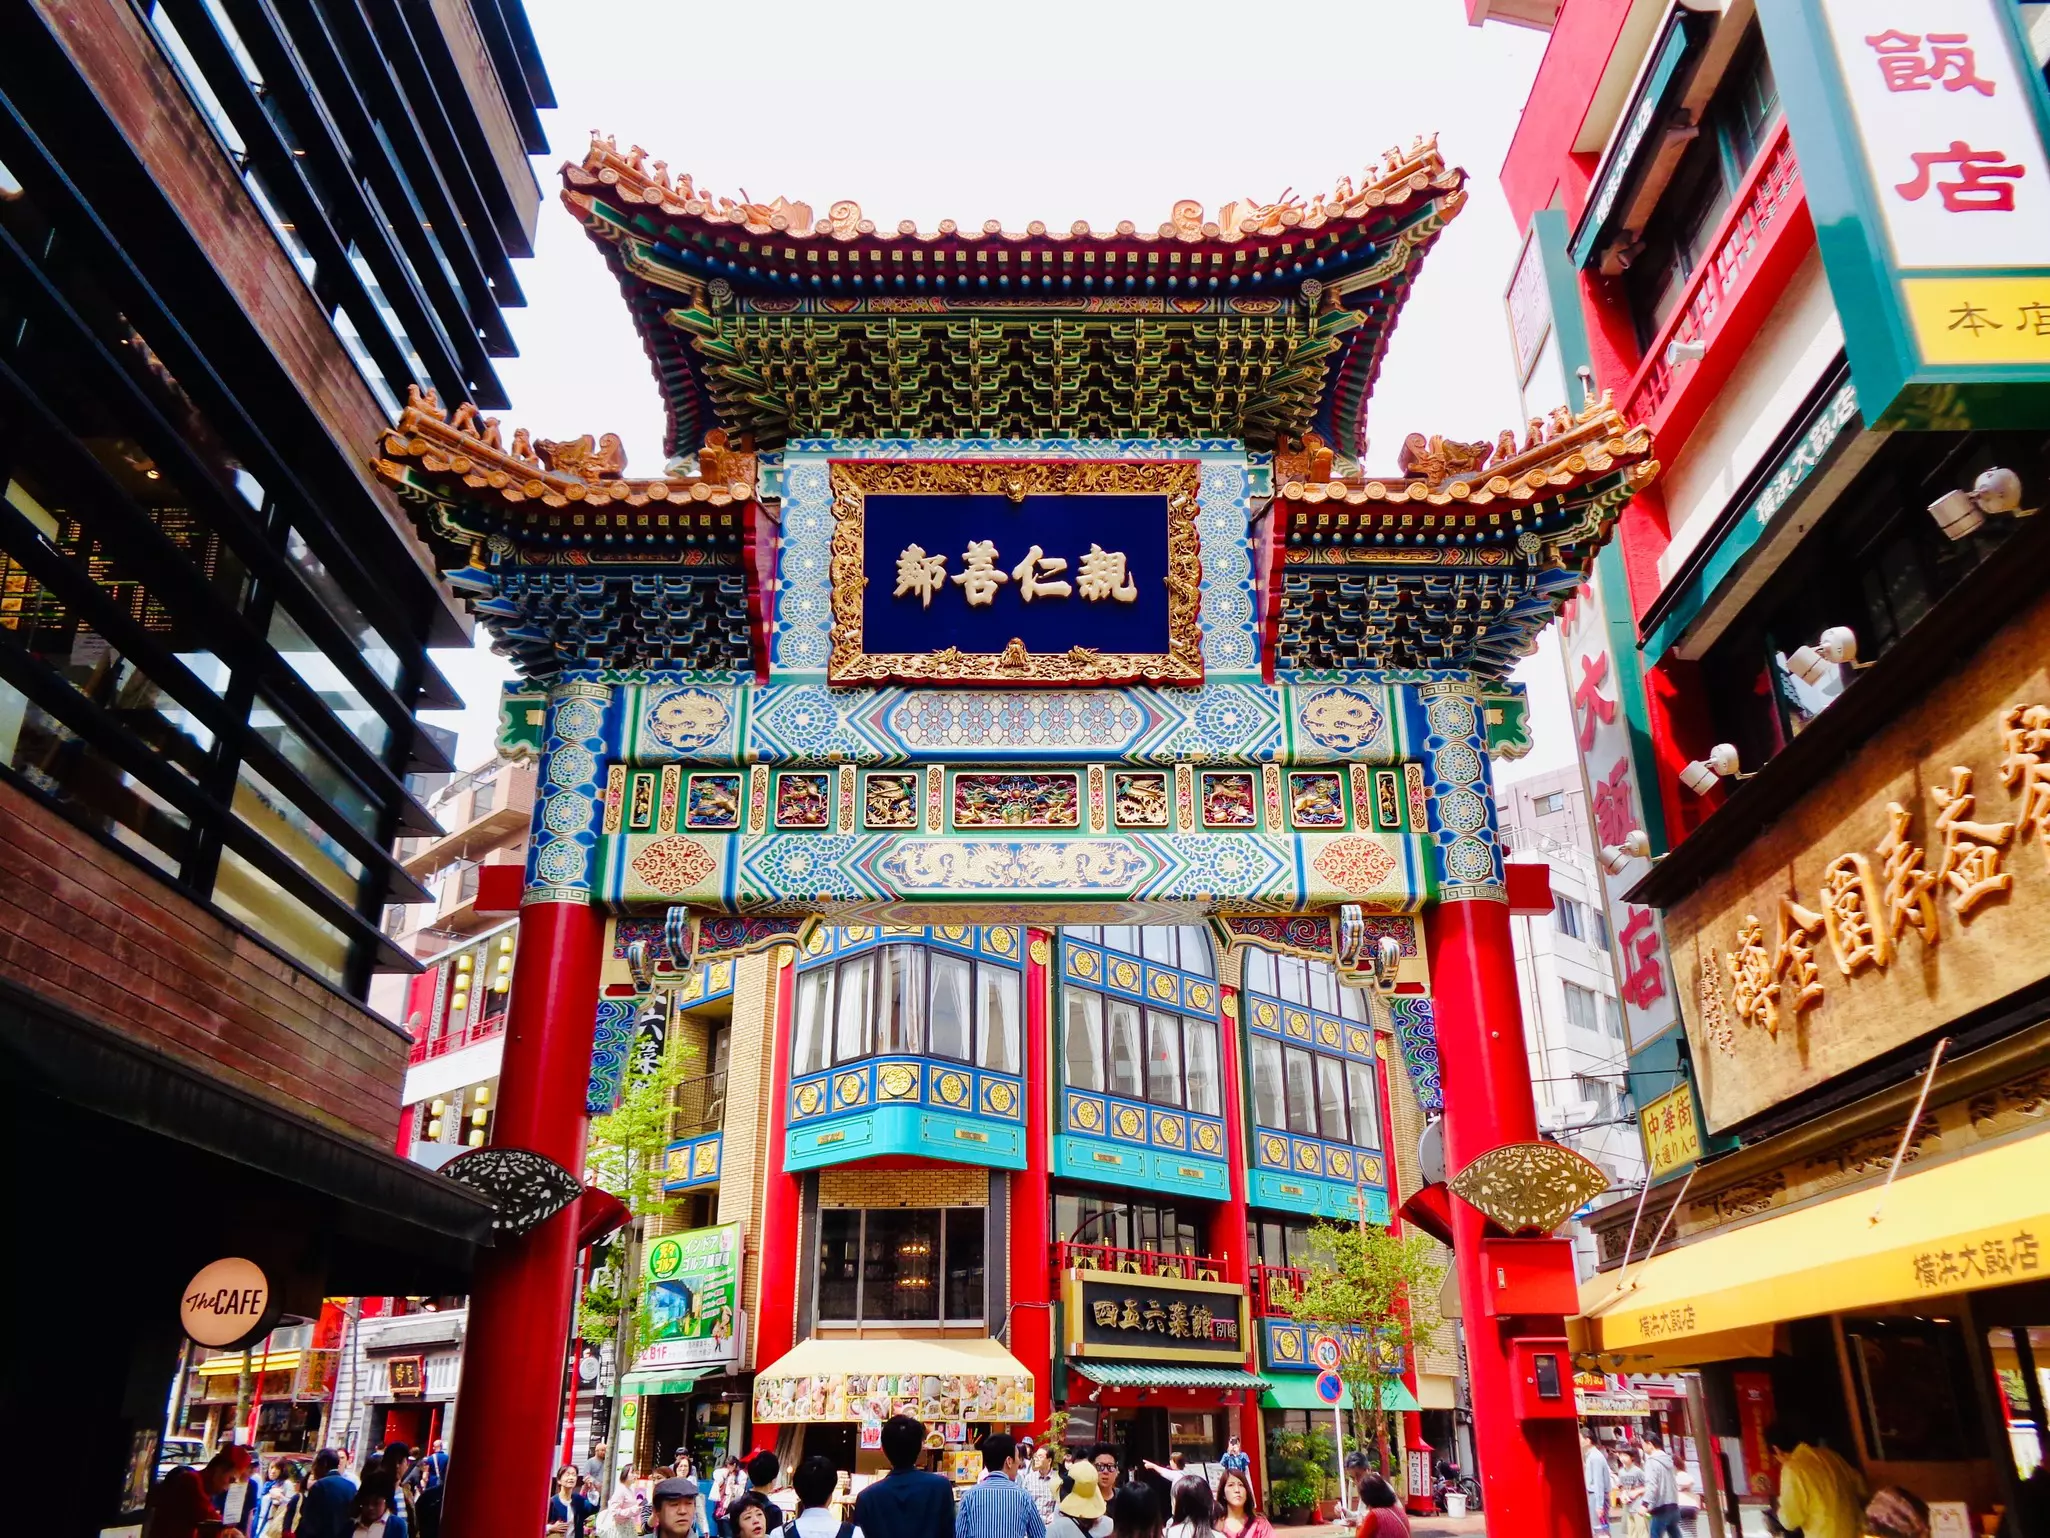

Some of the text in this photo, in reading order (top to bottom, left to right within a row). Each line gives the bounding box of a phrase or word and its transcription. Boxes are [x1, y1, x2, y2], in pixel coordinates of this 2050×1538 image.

[1865, 29, 2026, 213] 飯店
[1648, 1095, 1692, 1141] 中華街
[685, 1235, 719, 1254] インドア
[1913, 1229, 2039, 1289] 横浜大飯店
[186, 1289, 263, 1315] The CAFE
[649, 1346, 668, 1360] B1F
[1320, 1346, 1336, 1362] 30
